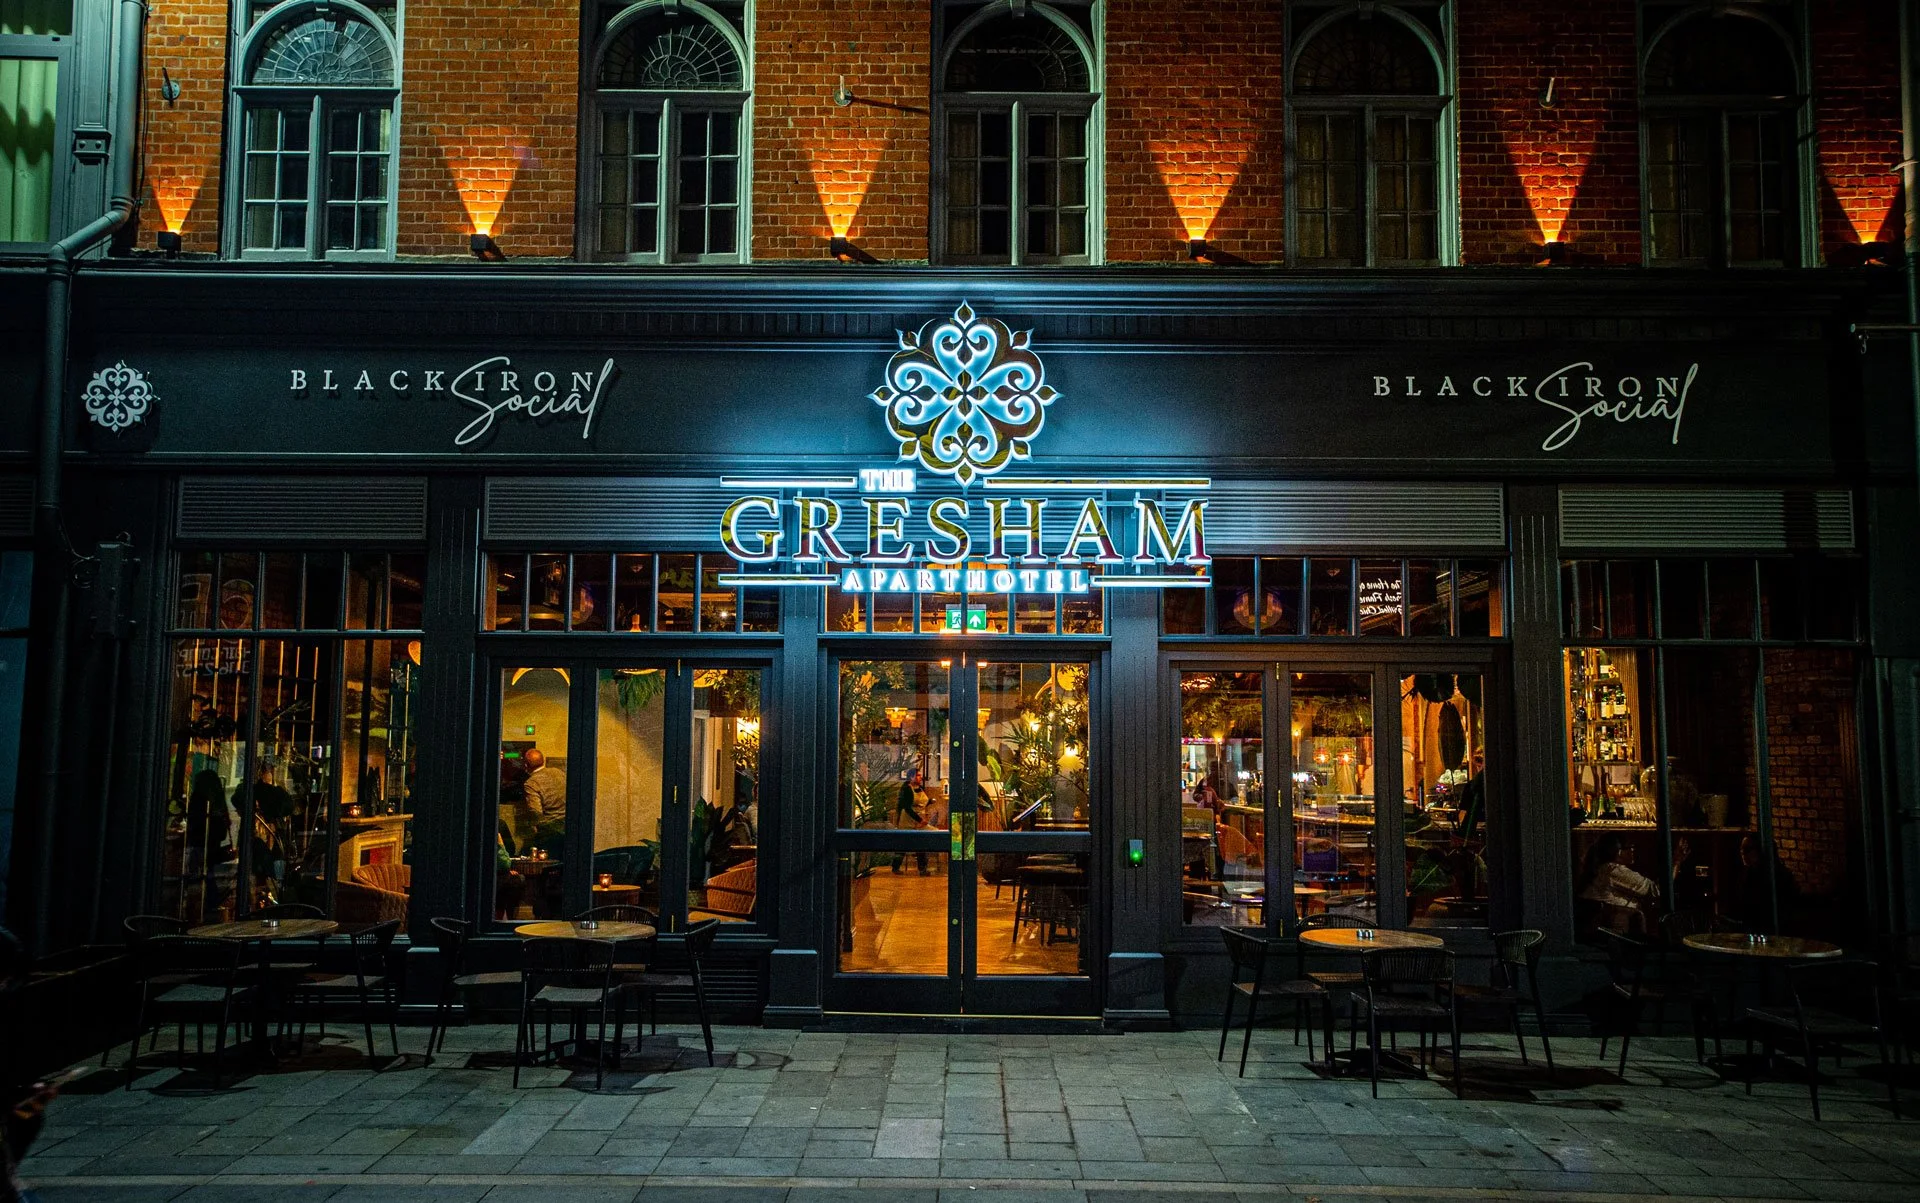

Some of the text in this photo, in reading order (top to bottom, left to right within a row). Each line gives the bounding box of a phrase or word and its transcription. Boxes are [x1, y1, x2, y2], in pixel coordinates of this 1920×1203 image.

[290, 369, 594, 392] BLACK IRON
[1373, 375, 1679, 398] BLACK IRON
[450, 356, 614, 445] Social
[1534, 361, 1699, 451] Social
[860, 468, 915, 492] THE
[718, 495, 1214, 563] GRESHAM
[842, 569, 1089, 592] APARTHOTEL
